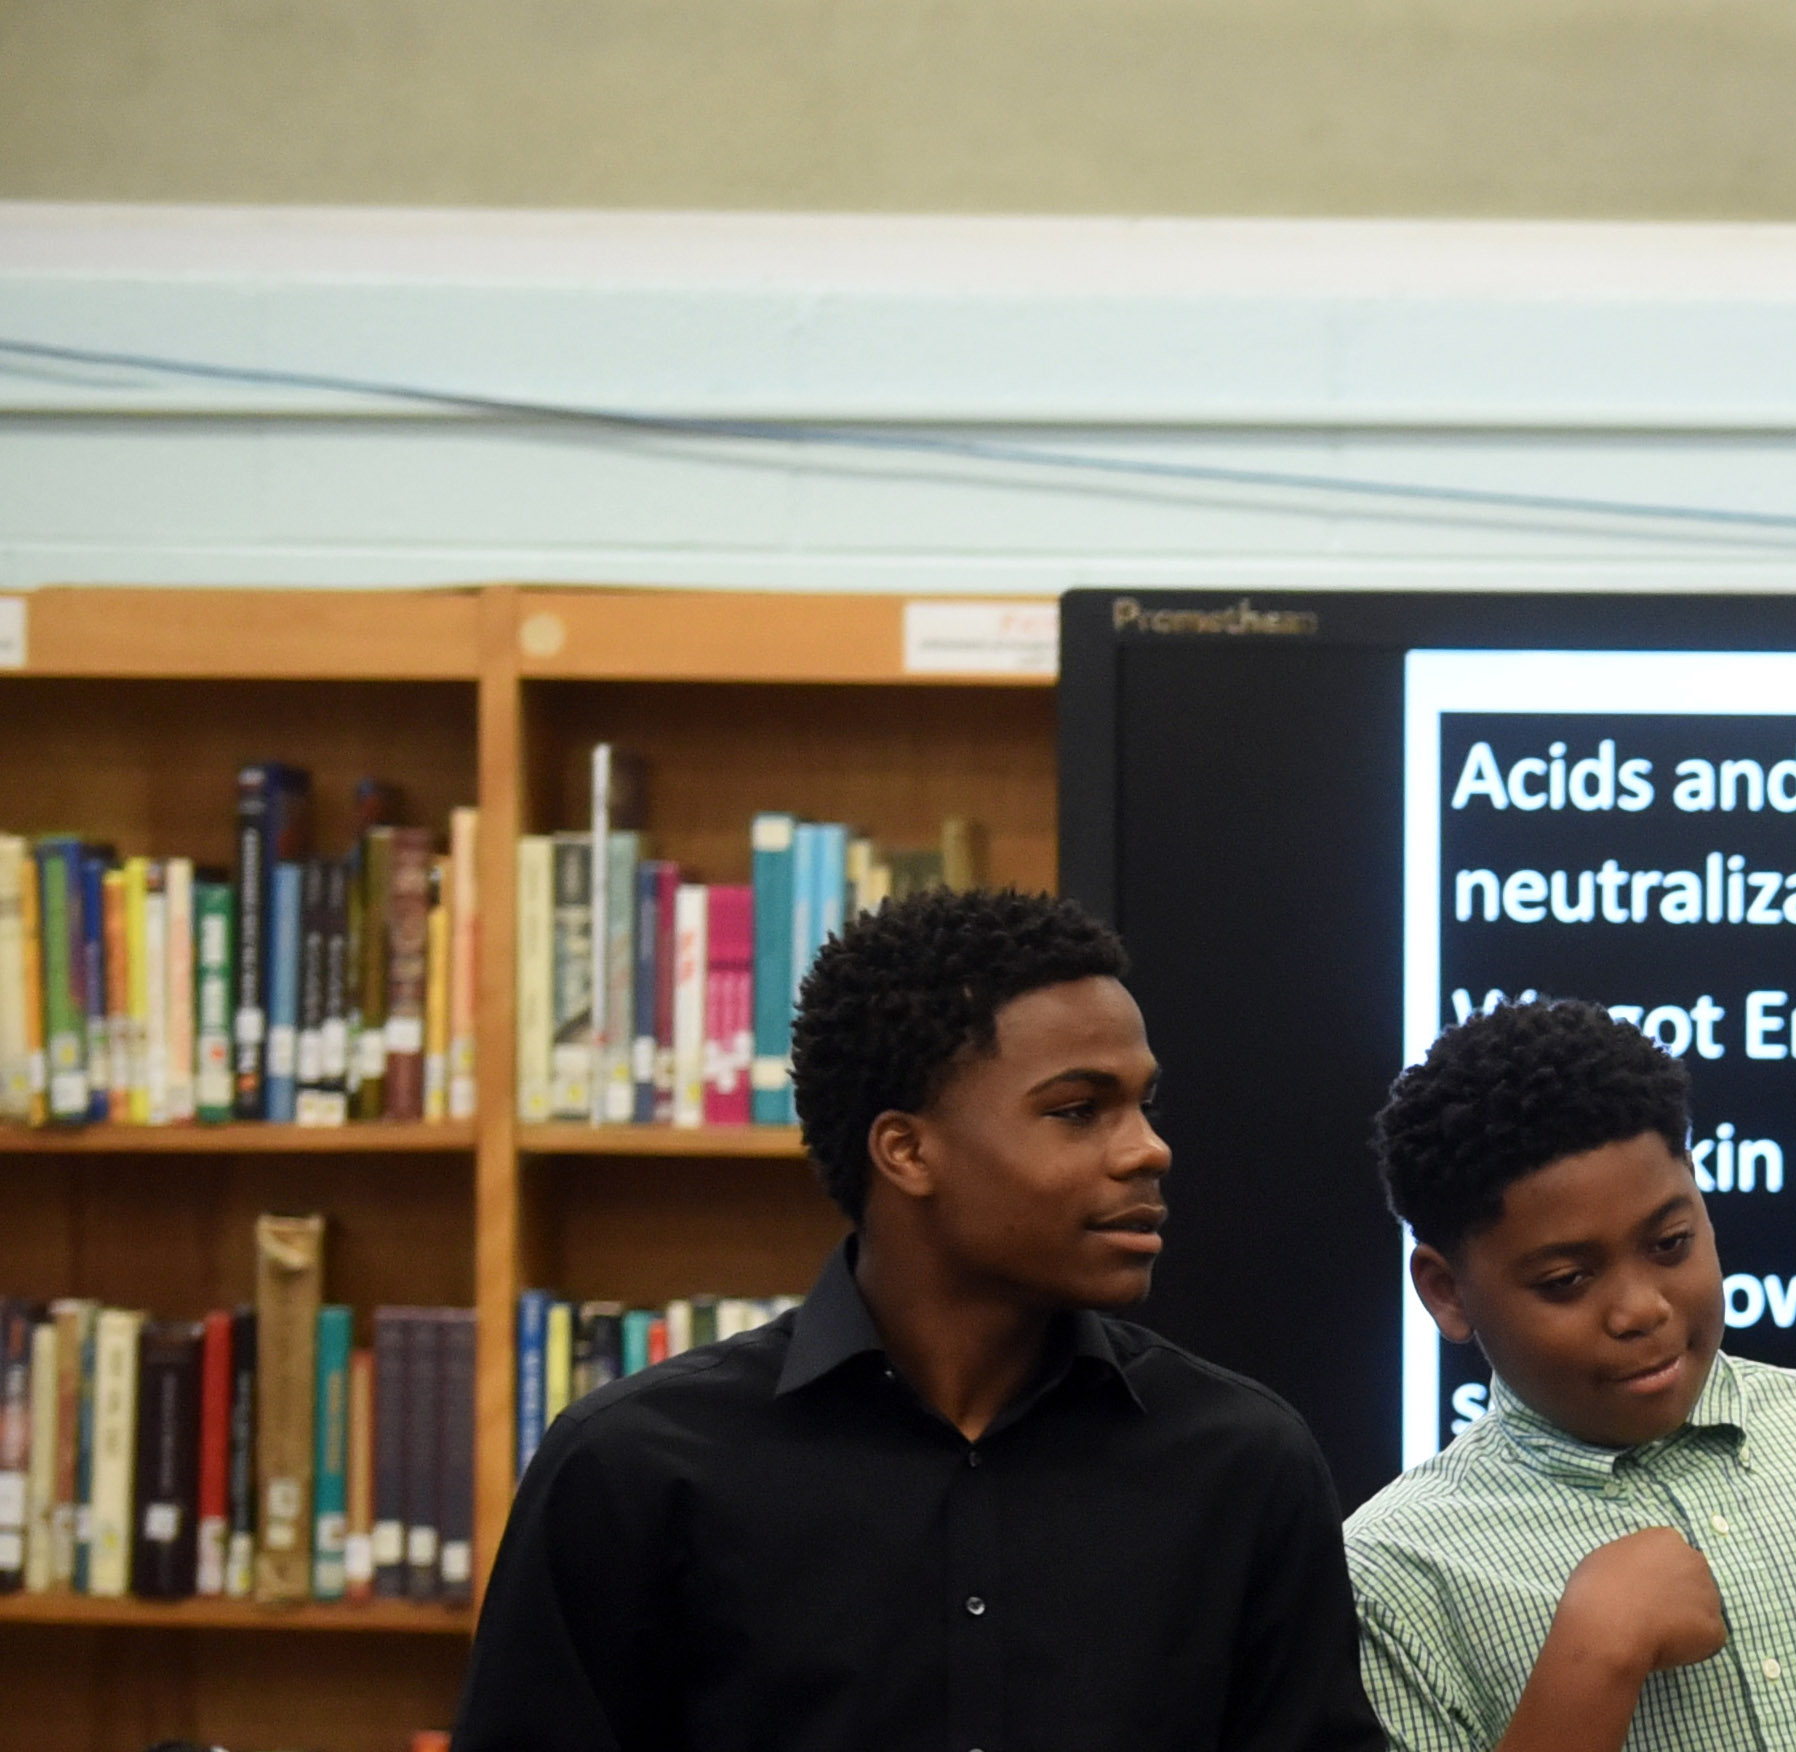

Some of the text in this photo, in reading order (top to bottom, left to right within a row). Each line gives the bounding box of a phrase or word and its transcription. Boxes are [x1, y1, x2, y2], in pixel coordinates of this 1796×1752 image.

[1451, 739, 1654, 814] Acids
[1606, 994, 1726, 1061] ot
[1686, 1121, 1784, 1194] kin
